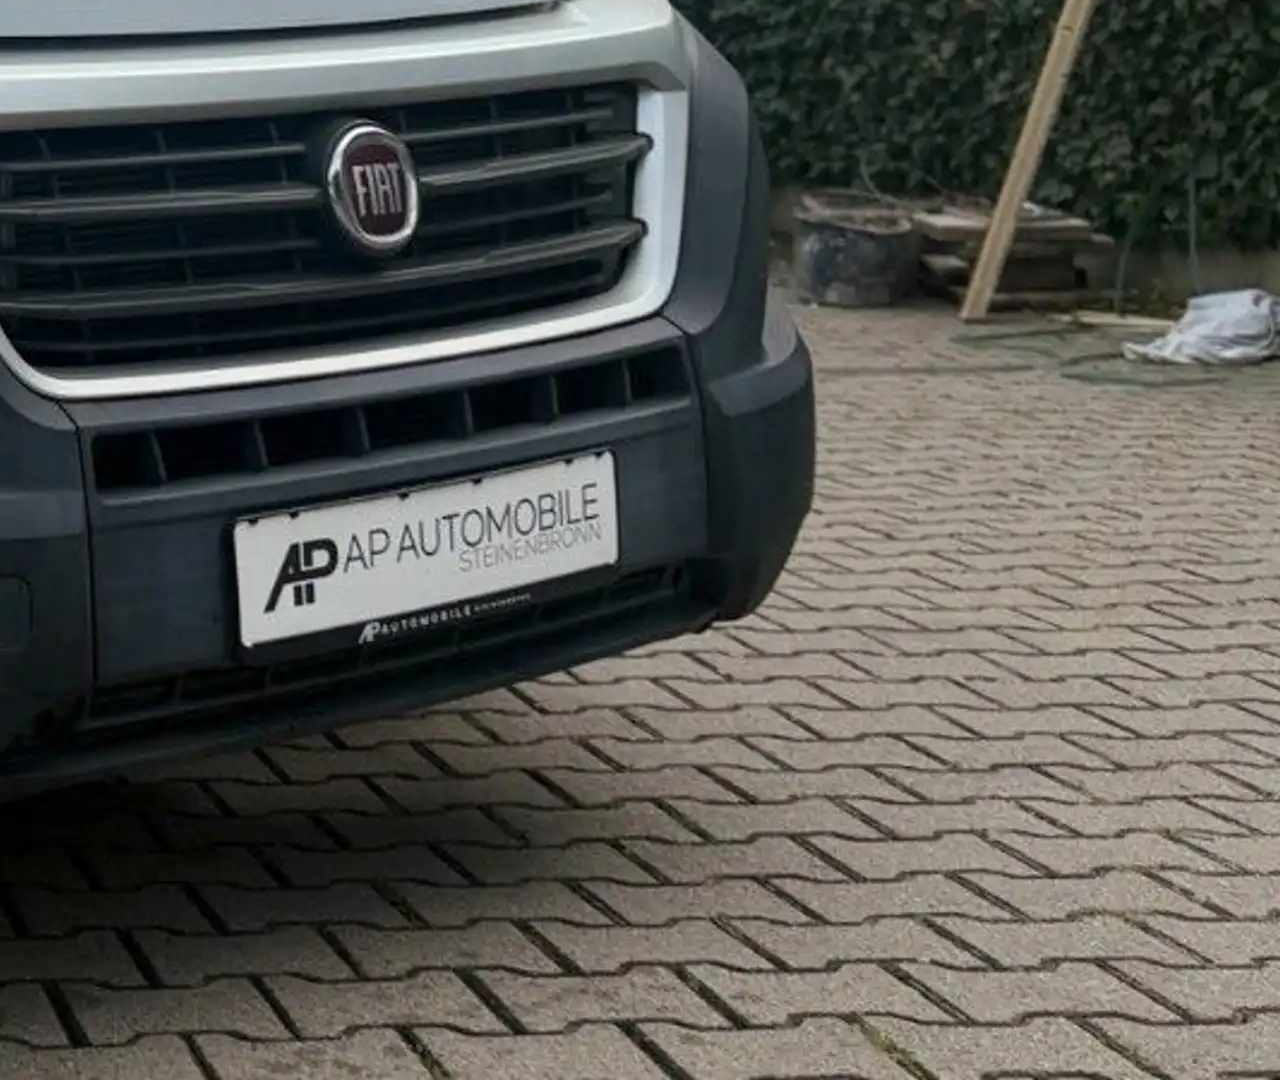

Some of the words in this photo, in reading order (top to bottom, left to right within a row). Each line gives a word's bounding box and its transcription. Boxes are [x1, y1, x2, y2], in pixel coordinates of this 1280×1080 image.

[352, 162, 403, 217] FIAT
[343, 527, 391, 573] AP
[396, 482, 599, 562] AUTOMOBILE
[459, 522, 603, 572] STEINENBRONN
